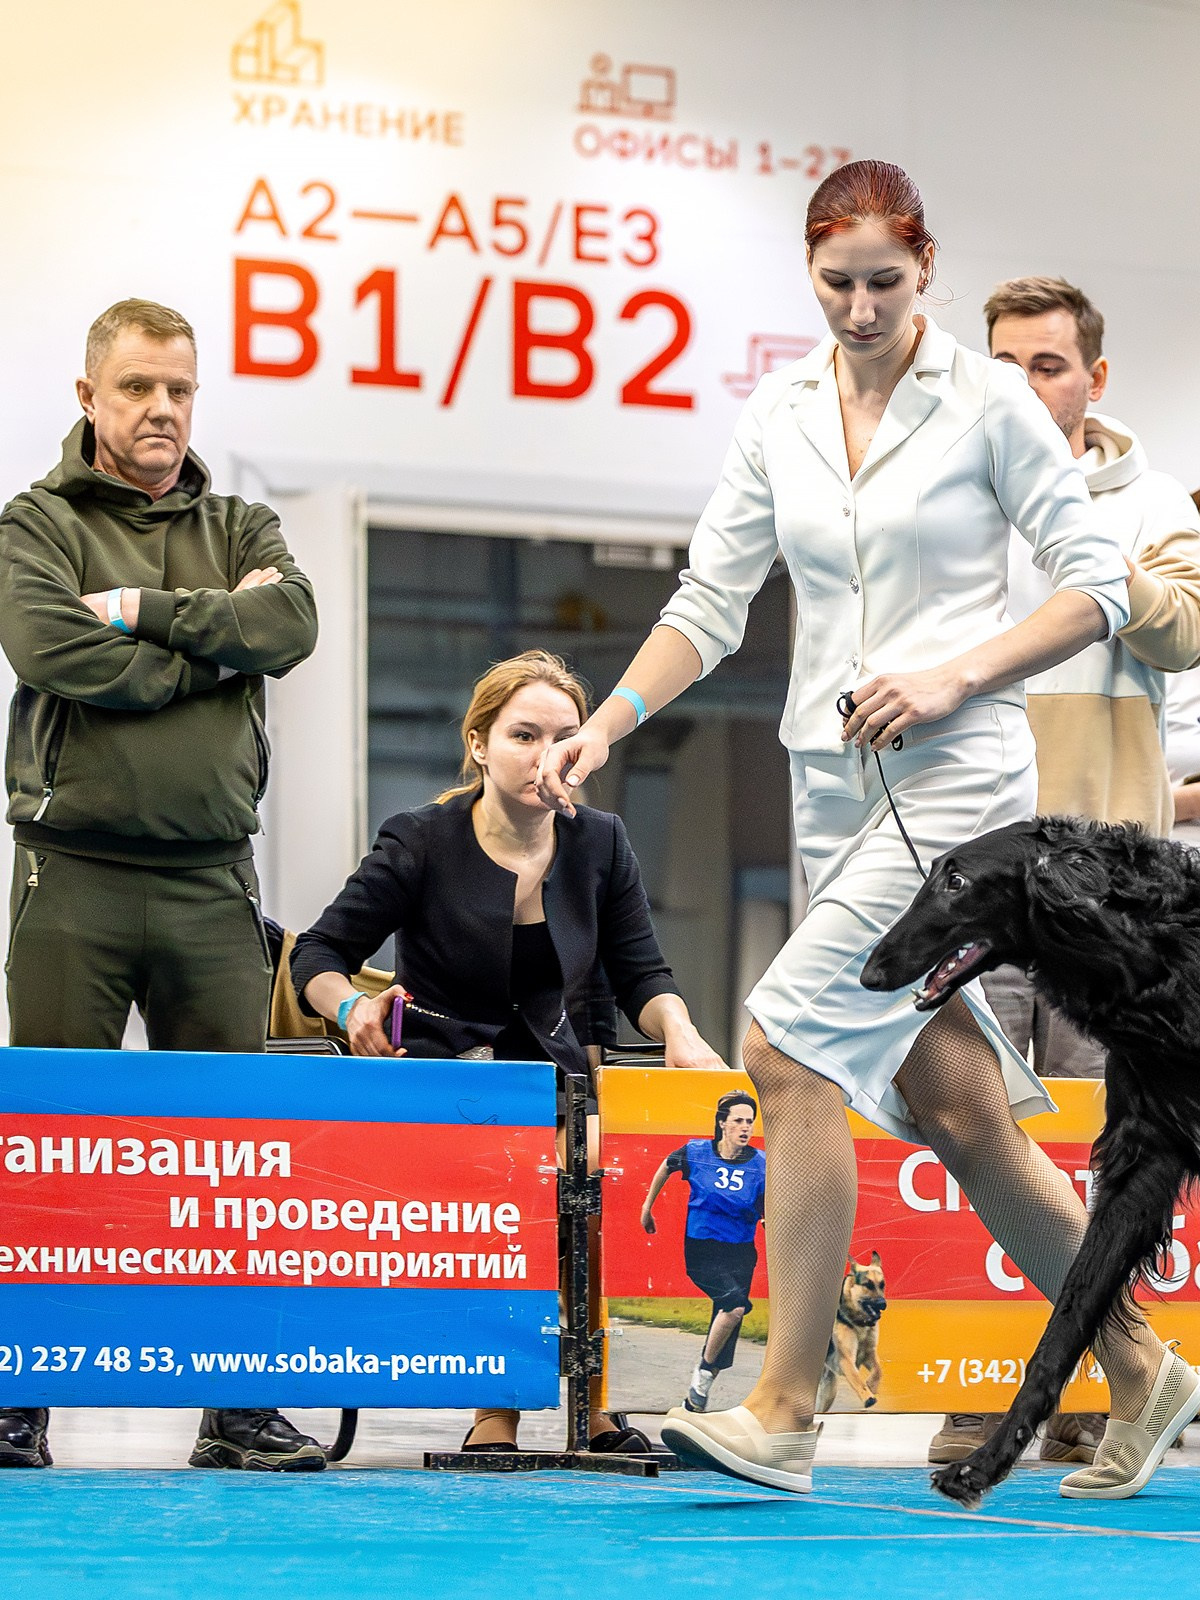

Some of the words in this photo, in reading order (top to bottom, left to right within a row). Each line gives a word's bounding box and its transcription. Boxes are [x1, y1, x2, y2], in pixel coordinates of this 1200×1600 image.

[233, 91, 464, 147] ХРАНЕНИЕ
[573, 123, 739, 170] ОФИСЫ
[0, 1134, 291, 1186] анизация
[714, 1167, 745, 1191] 35
[169, 1196, 200, 1228] и
[214, 1197, 521, 1241] проведение
[246, 1244, 527, 1287] мероприятий
[31, 1346, 87, 1372] 237
[94, 1346, 131, 1372] 48
[139, 1346, 184, 1377] 53,
[191, 1345, 506, 1381] www.sobaka-perm.ru
[917, 1359, 952, 1384] +7
[959, 1357, 1027, 1388] (342)
